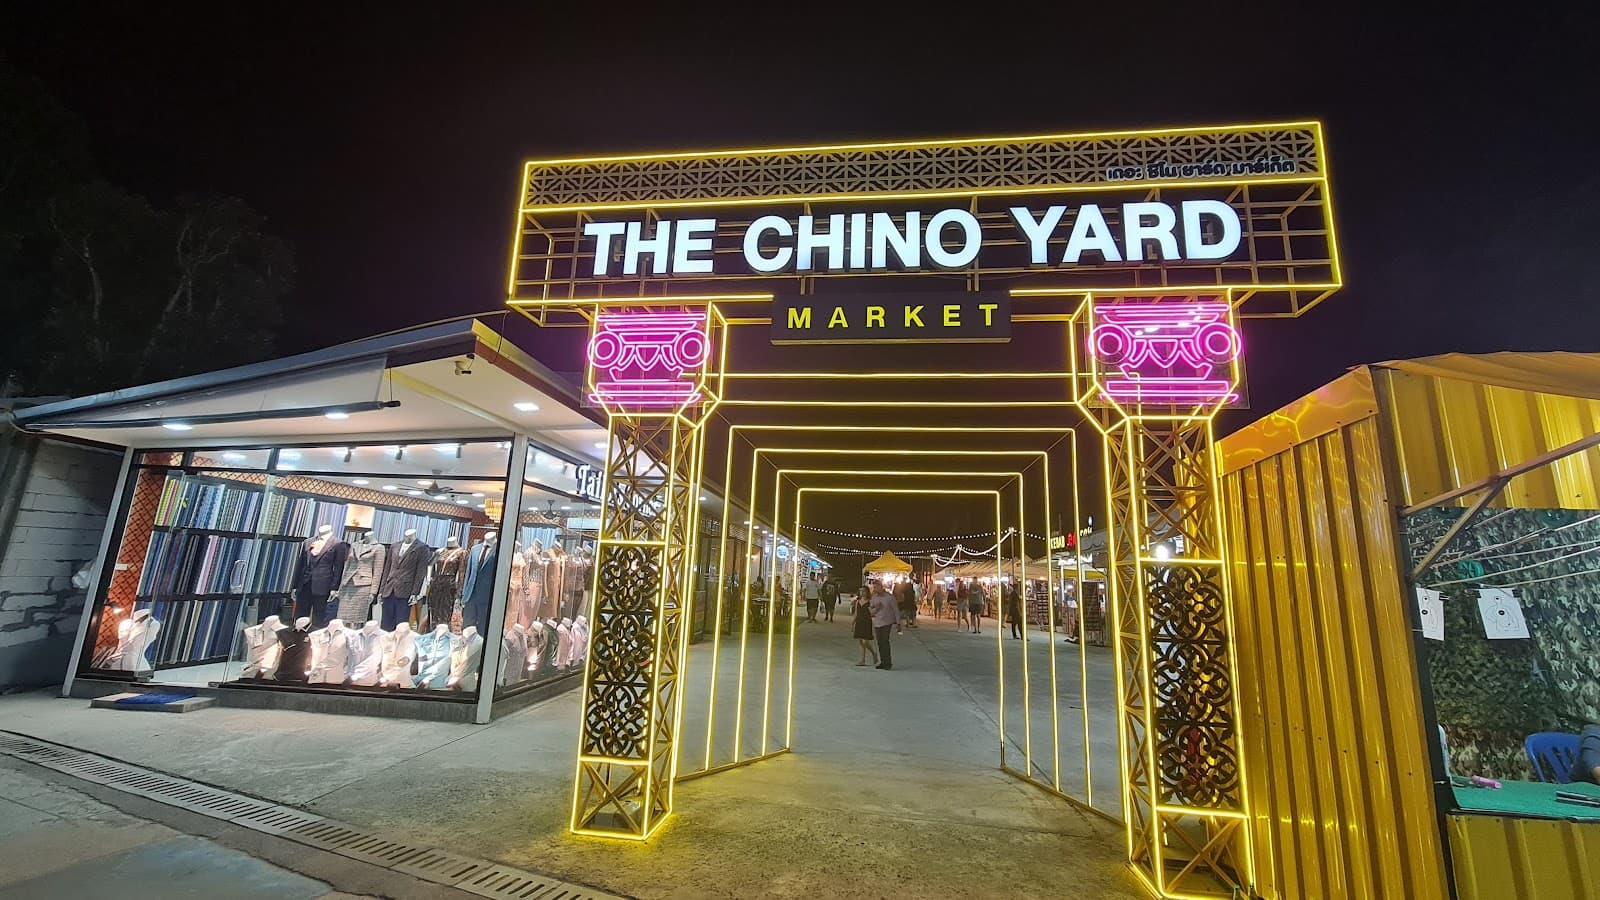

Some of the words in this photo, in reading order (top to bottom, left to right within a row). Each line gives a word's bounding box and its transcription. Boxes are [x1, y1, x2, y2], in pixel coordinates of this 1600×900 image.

[584, 218, 717, 276] THE
[742, 207, 983, 272] CHINO
[1009, 199, 1243, 264] YARD
[786, 303, 999, 329] MARKET
